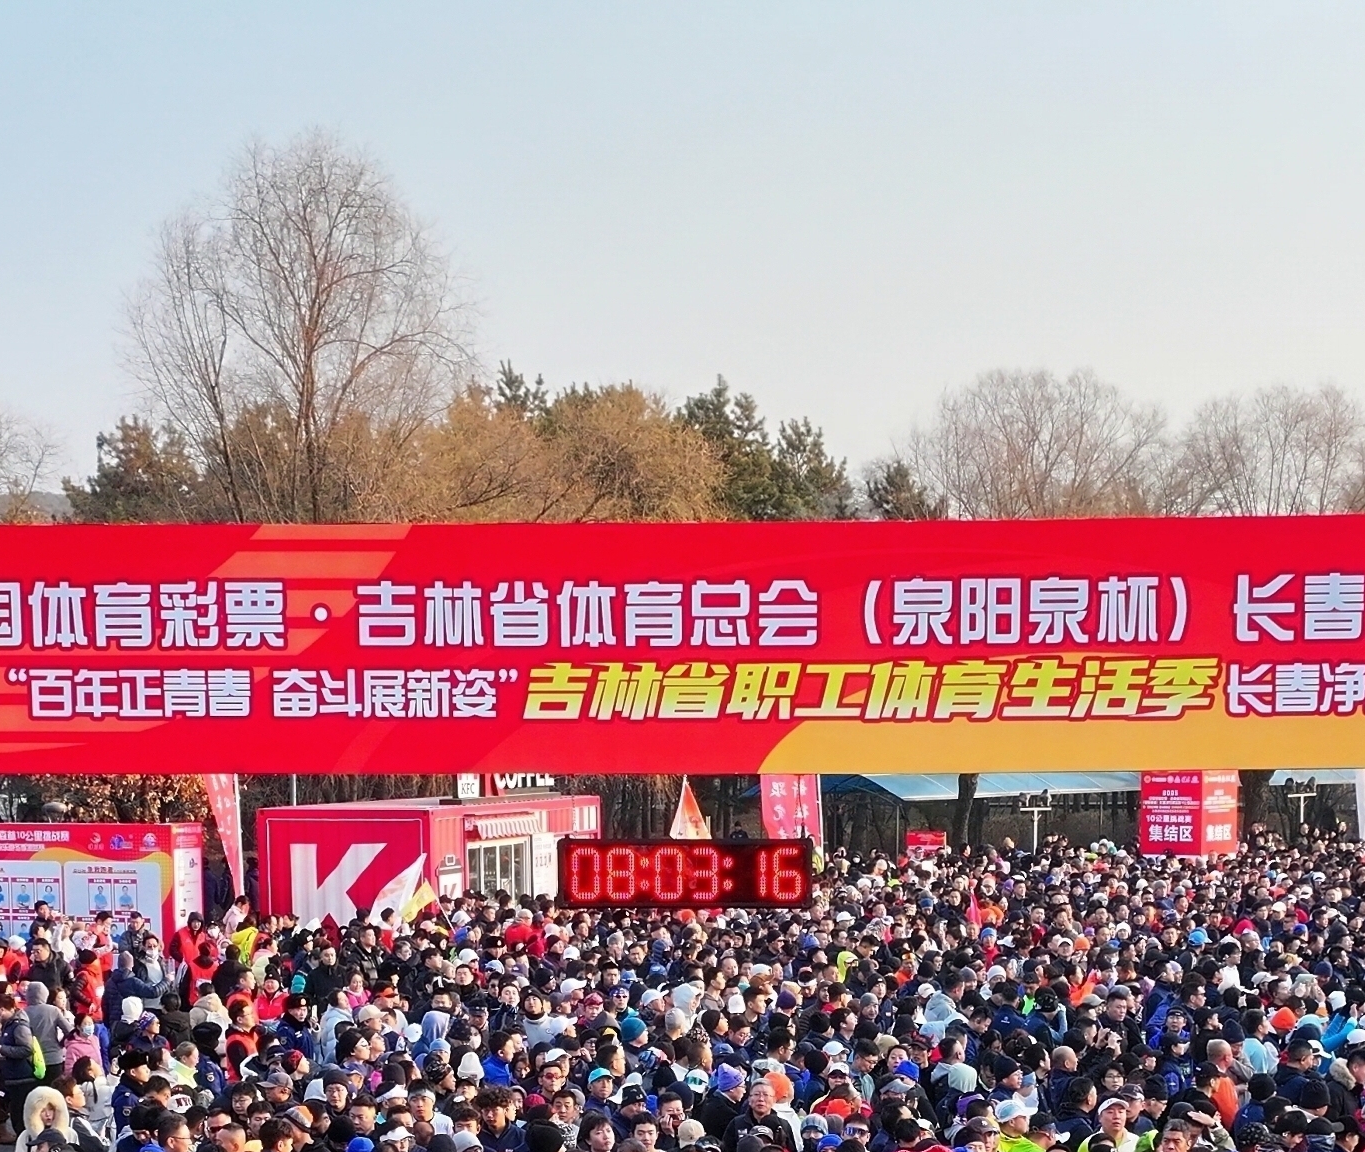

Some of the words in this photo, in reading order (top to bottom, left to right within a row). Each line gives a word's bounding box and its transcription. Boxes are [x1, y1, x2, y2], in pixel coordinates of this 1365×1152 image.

[461, 782, 475, 795] KFC
[1149, 824, 1193, 842] 集结区
